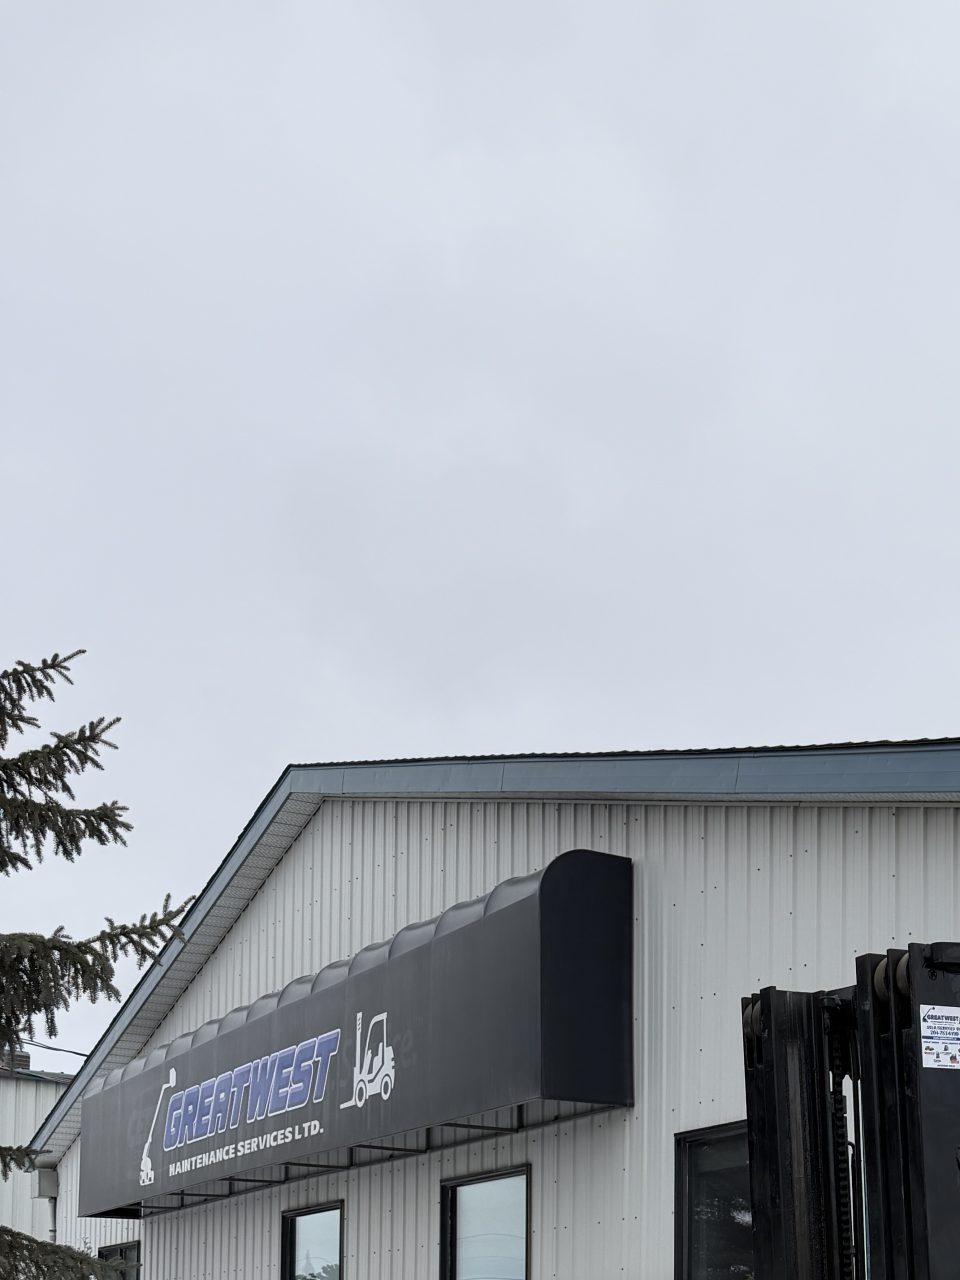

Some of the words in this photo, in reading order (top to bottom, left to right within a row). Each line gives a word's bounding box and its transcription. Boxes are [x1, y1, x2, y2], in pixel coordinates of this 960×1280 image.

[168, 1144, 236, 1177] MAINTENANCE
[237, 1126, 293, 1156] SERVICES
[294, 1119, 325, 1140] LTD.
